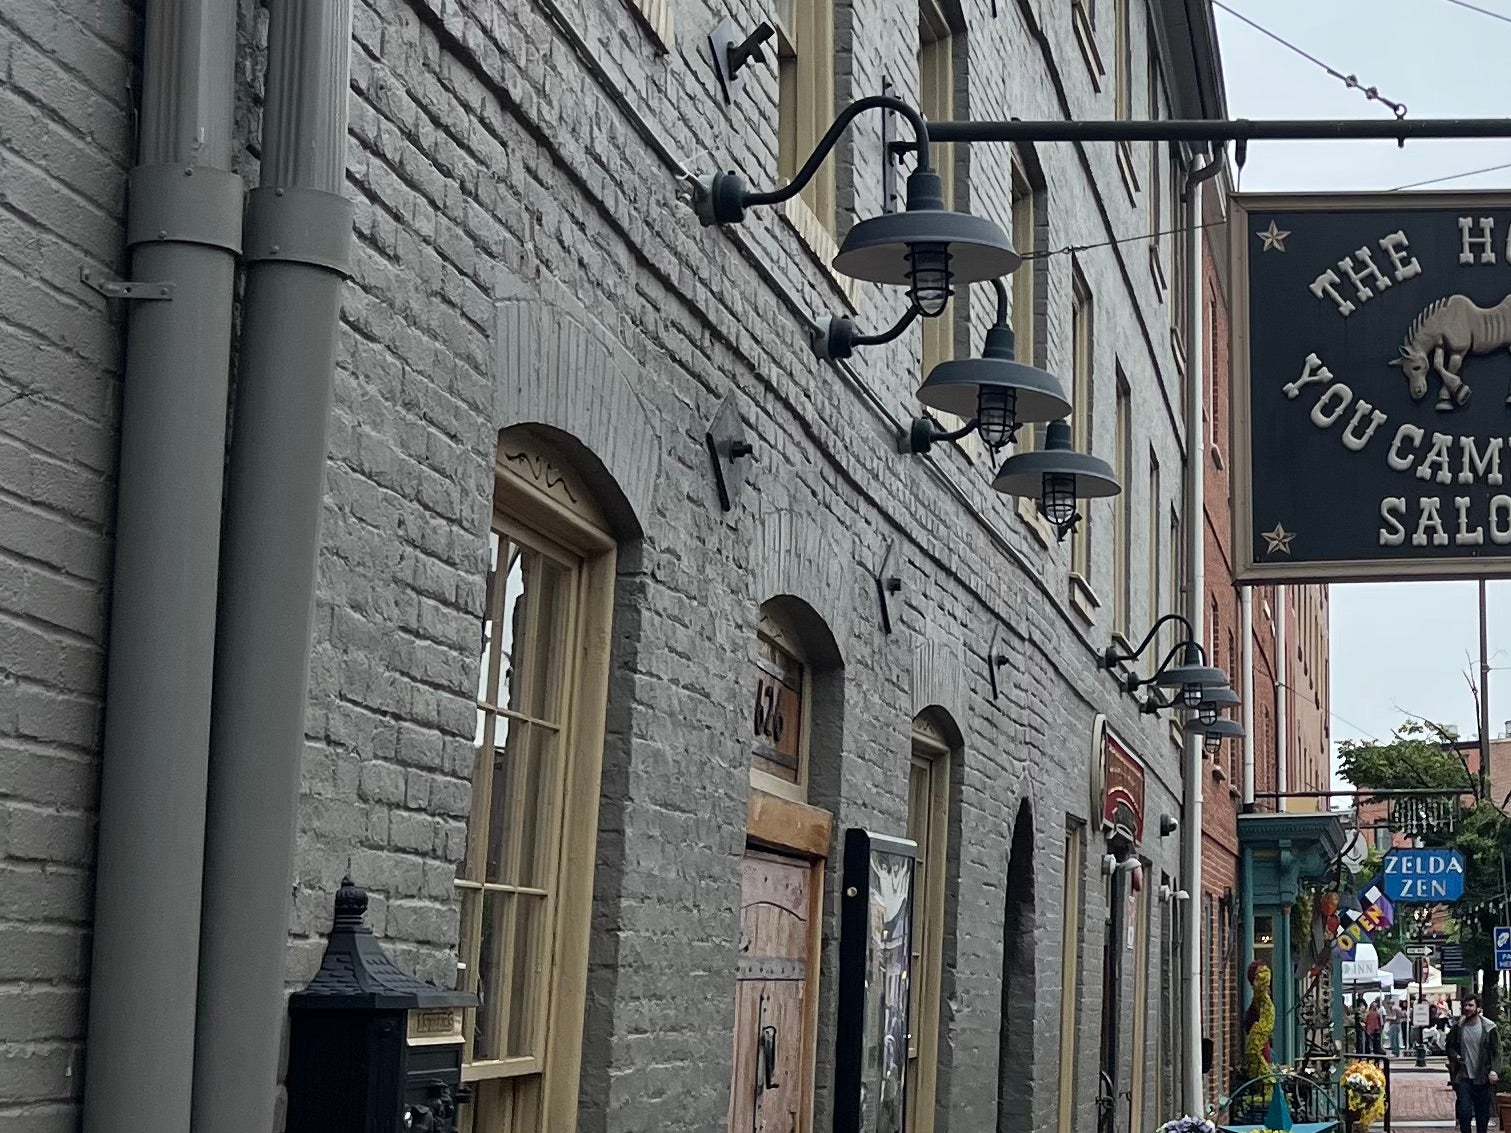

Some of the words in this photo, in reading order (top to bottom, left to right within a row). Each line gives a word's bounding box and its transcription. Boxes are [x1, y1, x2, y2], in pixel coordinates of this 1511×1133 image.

[1309, 230, 1422, 317] THE
[1282, 352, 1388, 451] YOU
[1384, 855, 1463, 875] ZELDA
[1400, 879, 1447, 898] ZEN
[1337, 903, 1384, 952] OPEN
